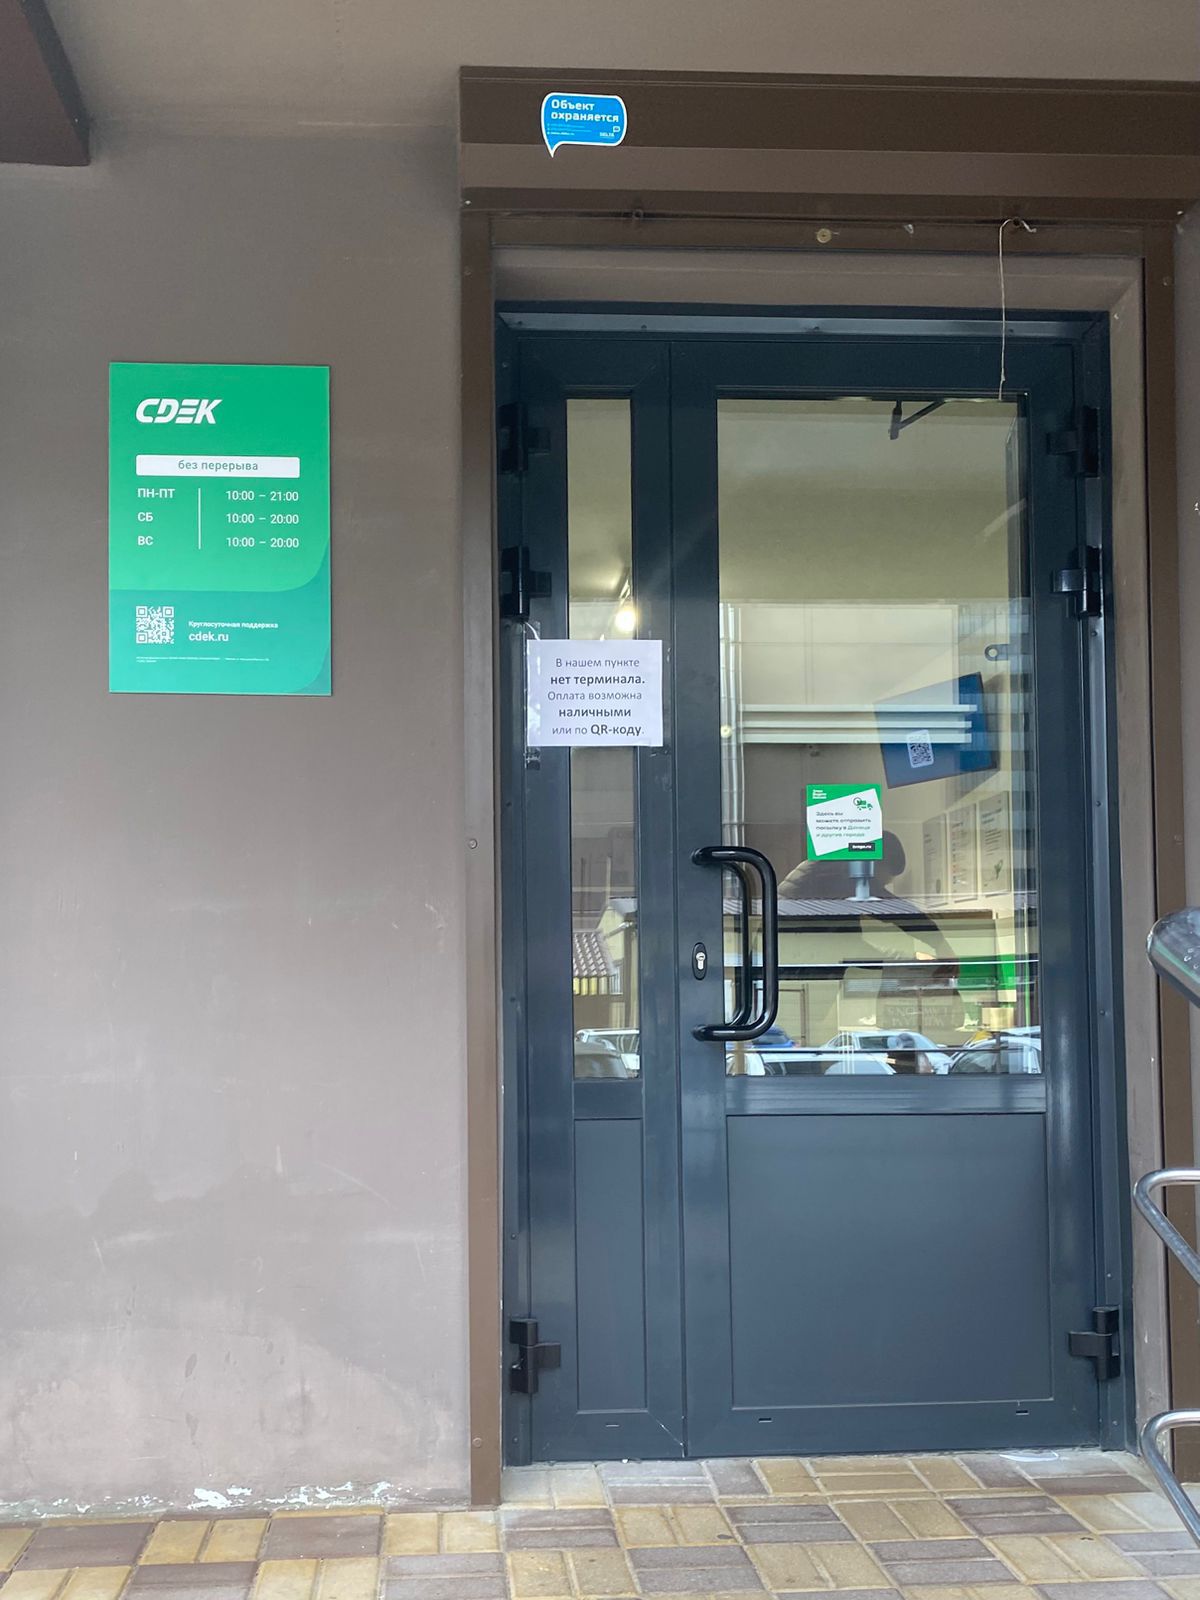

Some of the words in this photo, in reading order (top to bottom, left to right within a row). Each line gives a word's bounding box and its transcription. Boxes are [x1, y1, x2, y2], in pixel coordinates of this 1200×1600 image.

[551, 99, 595, 111] Объект
[551, 111, 619, 123] охраняется
[136, 398, 223, 424] CDEK
[178, 459, 198, 470] без
[201, 461, 259, 473] перерыва
[137, 488, 176, 499] ПН-ПТ
[226, 490, 255, 501] 10:00
[270, 491, 299, 502] 21:00
[137, 512, 154, 522] СБ
[226, 513, 255, 524] 10:00
[270, 514, 300, 524] 20:00
[137, 536, 154, 546] ВС
[226, 537, 255, 547] 10:00
[270, 538, 300, 548] 20:00
[188, 621, 240, 630] Круглосуточная
[241, 622, 278, 630] поддержка
[188, 631, 229, 642] cdek.ru
[555, 658, 562, 667] В
[565, 659, 602, 667] нашем
[604, 658, 640, 669] пункте
[550, 676, 571, 685] нет
[574, 675, 645, 686] терминала.
[547, 691, 586, 701] Оплата
[588, 691, 642, 701] возможна
[558, 708, 632, 718] наличными
[552, 727, 572, 735] или
[575, 727, 588, 735] по
